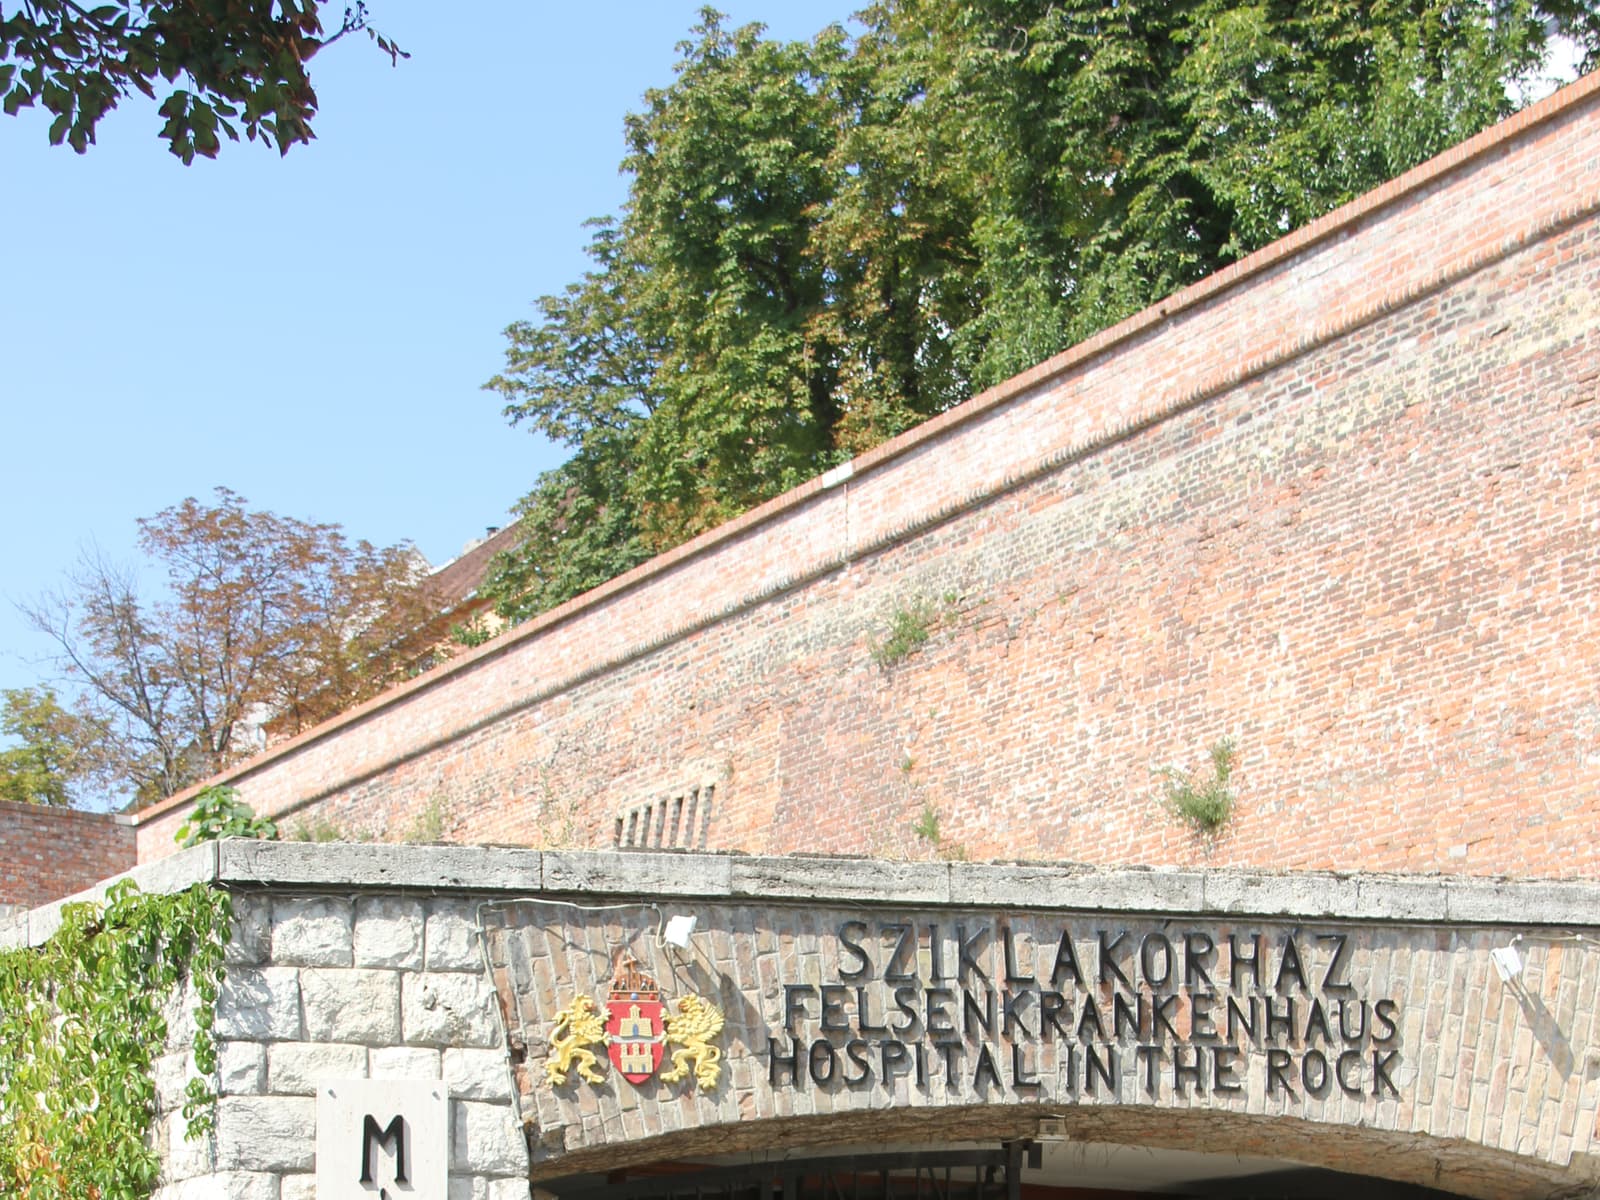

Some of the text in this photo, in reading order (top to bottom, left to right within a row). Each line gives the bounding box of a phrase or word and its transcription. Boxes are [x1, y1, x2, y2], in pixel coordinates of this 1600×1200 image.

[838, 918, 1352, 991] SZIKLAKÓRHÁZ
[784, 983, 1398, 1044] FELSENKRANKENHAUS
[768, 1037, 1399, 1097] HOSPITAL IN THE ROCK
